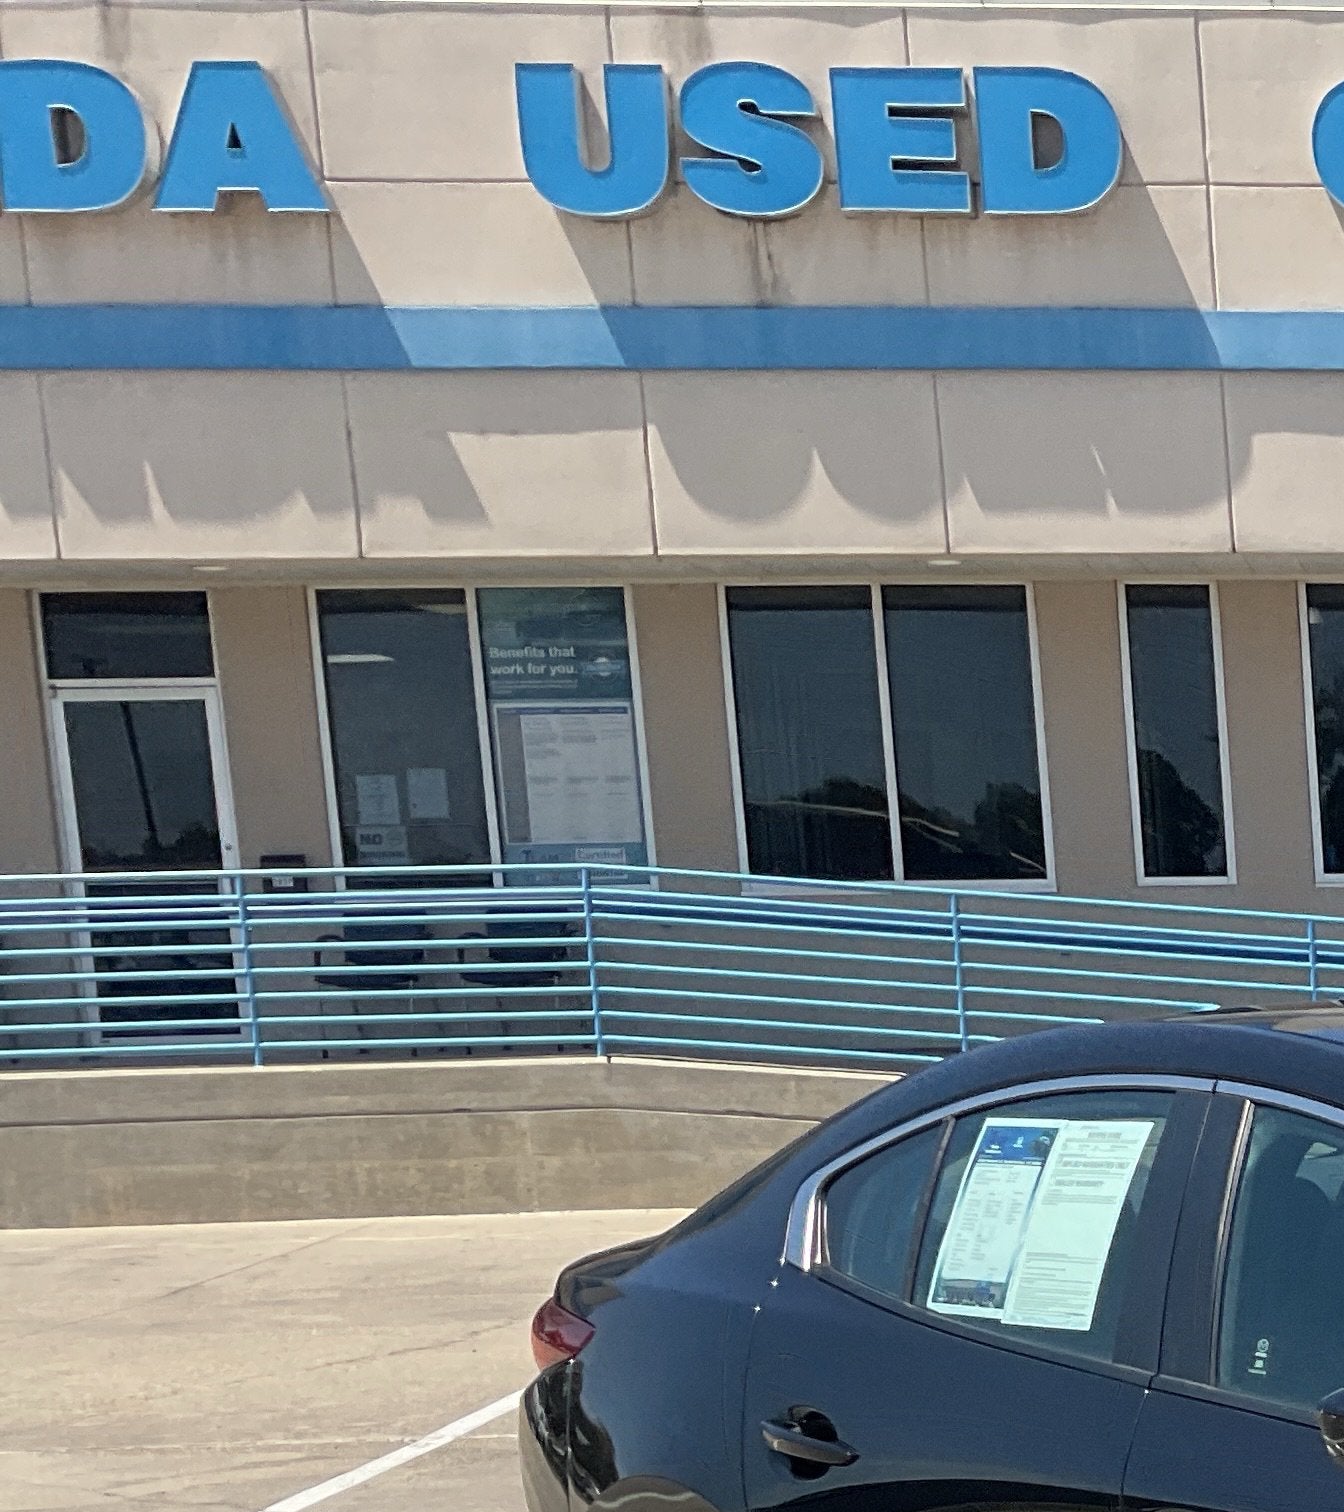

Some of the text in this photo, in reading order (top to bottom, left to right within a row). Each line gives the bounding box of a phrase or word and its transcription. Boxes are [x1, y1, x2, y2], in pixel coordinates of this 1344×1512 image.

[0, 59, 331, 213] DA
[514, 61, 1123, 218] USED
[489, 646, 576, 659] Benefits that
[490, 662, 525, 675] work
[527, 663, 547, 675] for
[550, 664, 579, 677] you.
